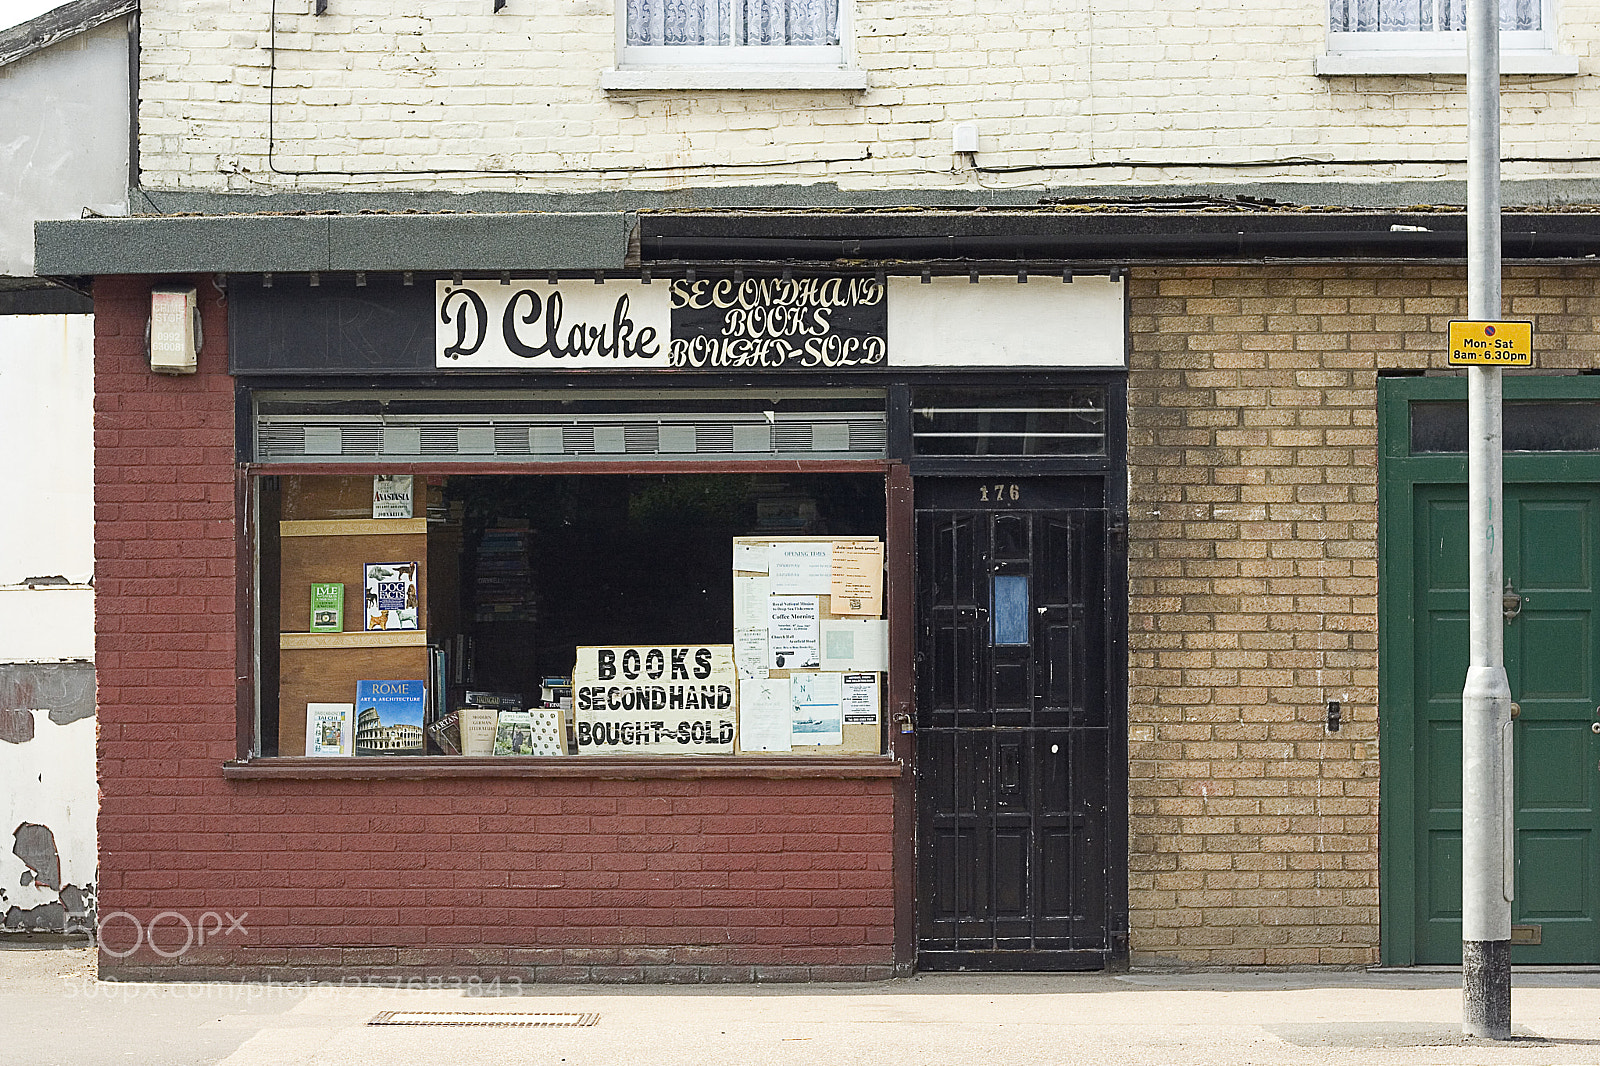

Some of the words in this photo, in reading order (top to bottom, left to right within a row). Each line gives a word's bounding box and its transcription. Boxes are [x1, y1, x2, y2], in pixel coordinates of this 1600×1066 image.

[670, 278, 884, 310] SECONDHAND
[440, 288, 488, 358] D
[502, 288, 660, 359] Clarke
[722, 307, 832, 338] BOOKS
[980, 484, 1020, 502] 176
[380, 583, 405, 592] DOG
[380, 591, 405, 599] FACTS
[598, 648, 712, 681] BOOKS
[372, 683, 409, 694] ROME
[578, 685, 732, 710] SECONDHAND
[800, 685, 806, 693] N
[806, 694, 812, 702] A
[429, 713, 459, 733] TARTAN
